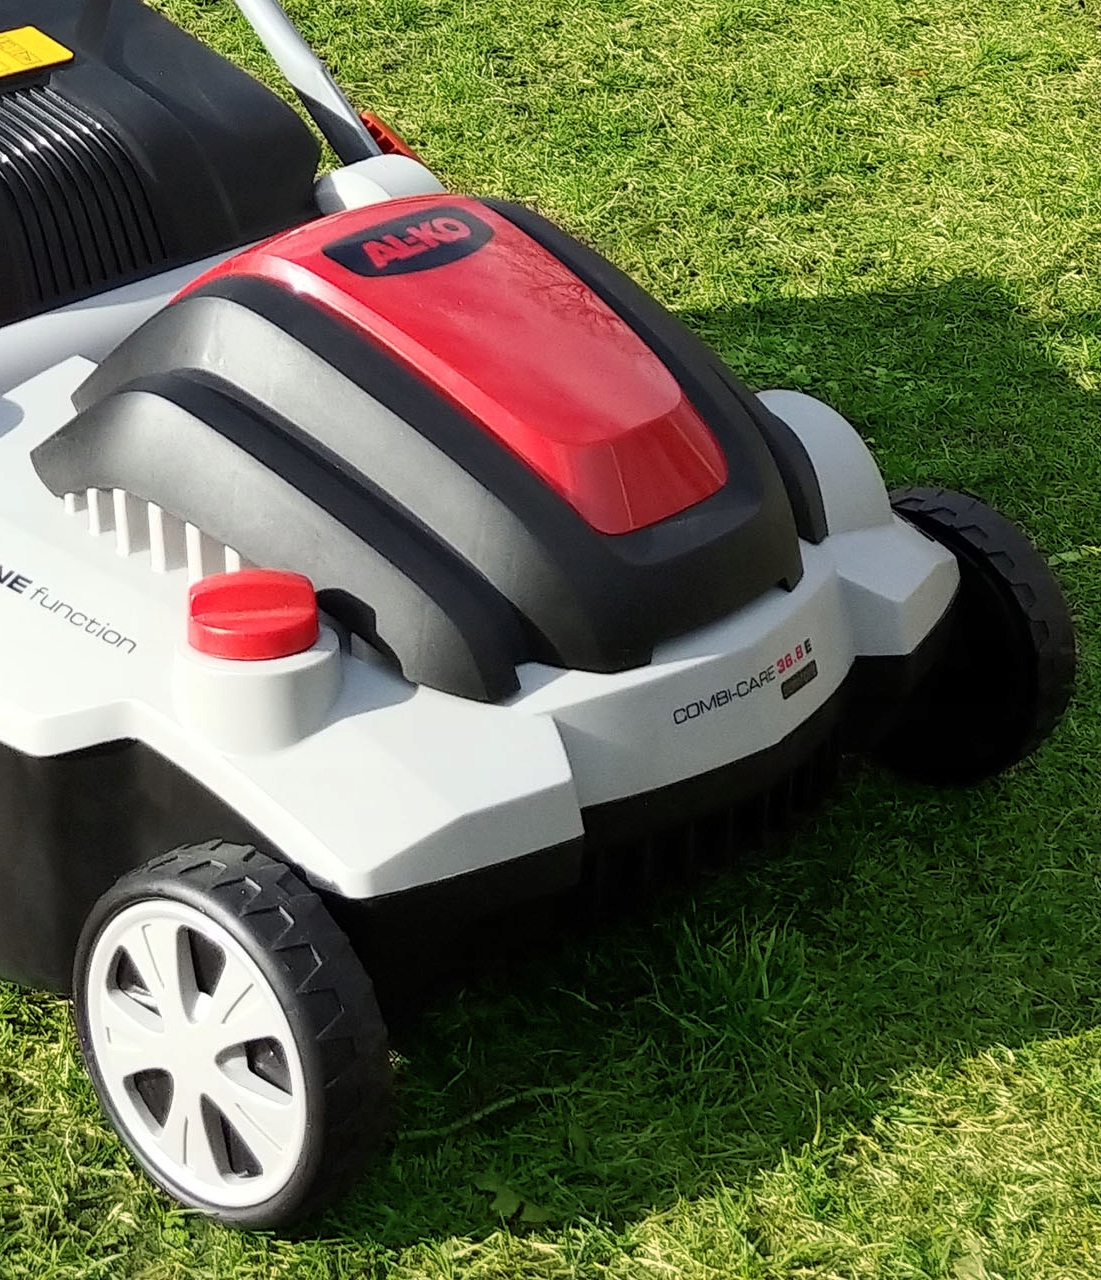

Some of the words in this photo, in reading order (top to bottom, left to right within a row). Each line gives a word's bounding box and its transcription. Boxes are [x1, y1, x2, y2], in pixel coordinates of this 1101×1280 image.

[362, 217, 471, 268] AL-KO
[30, 587, 137, 654] function
[673, 665, 777, 725] COMBI-CARE
[805, 638, 813, 654] E
